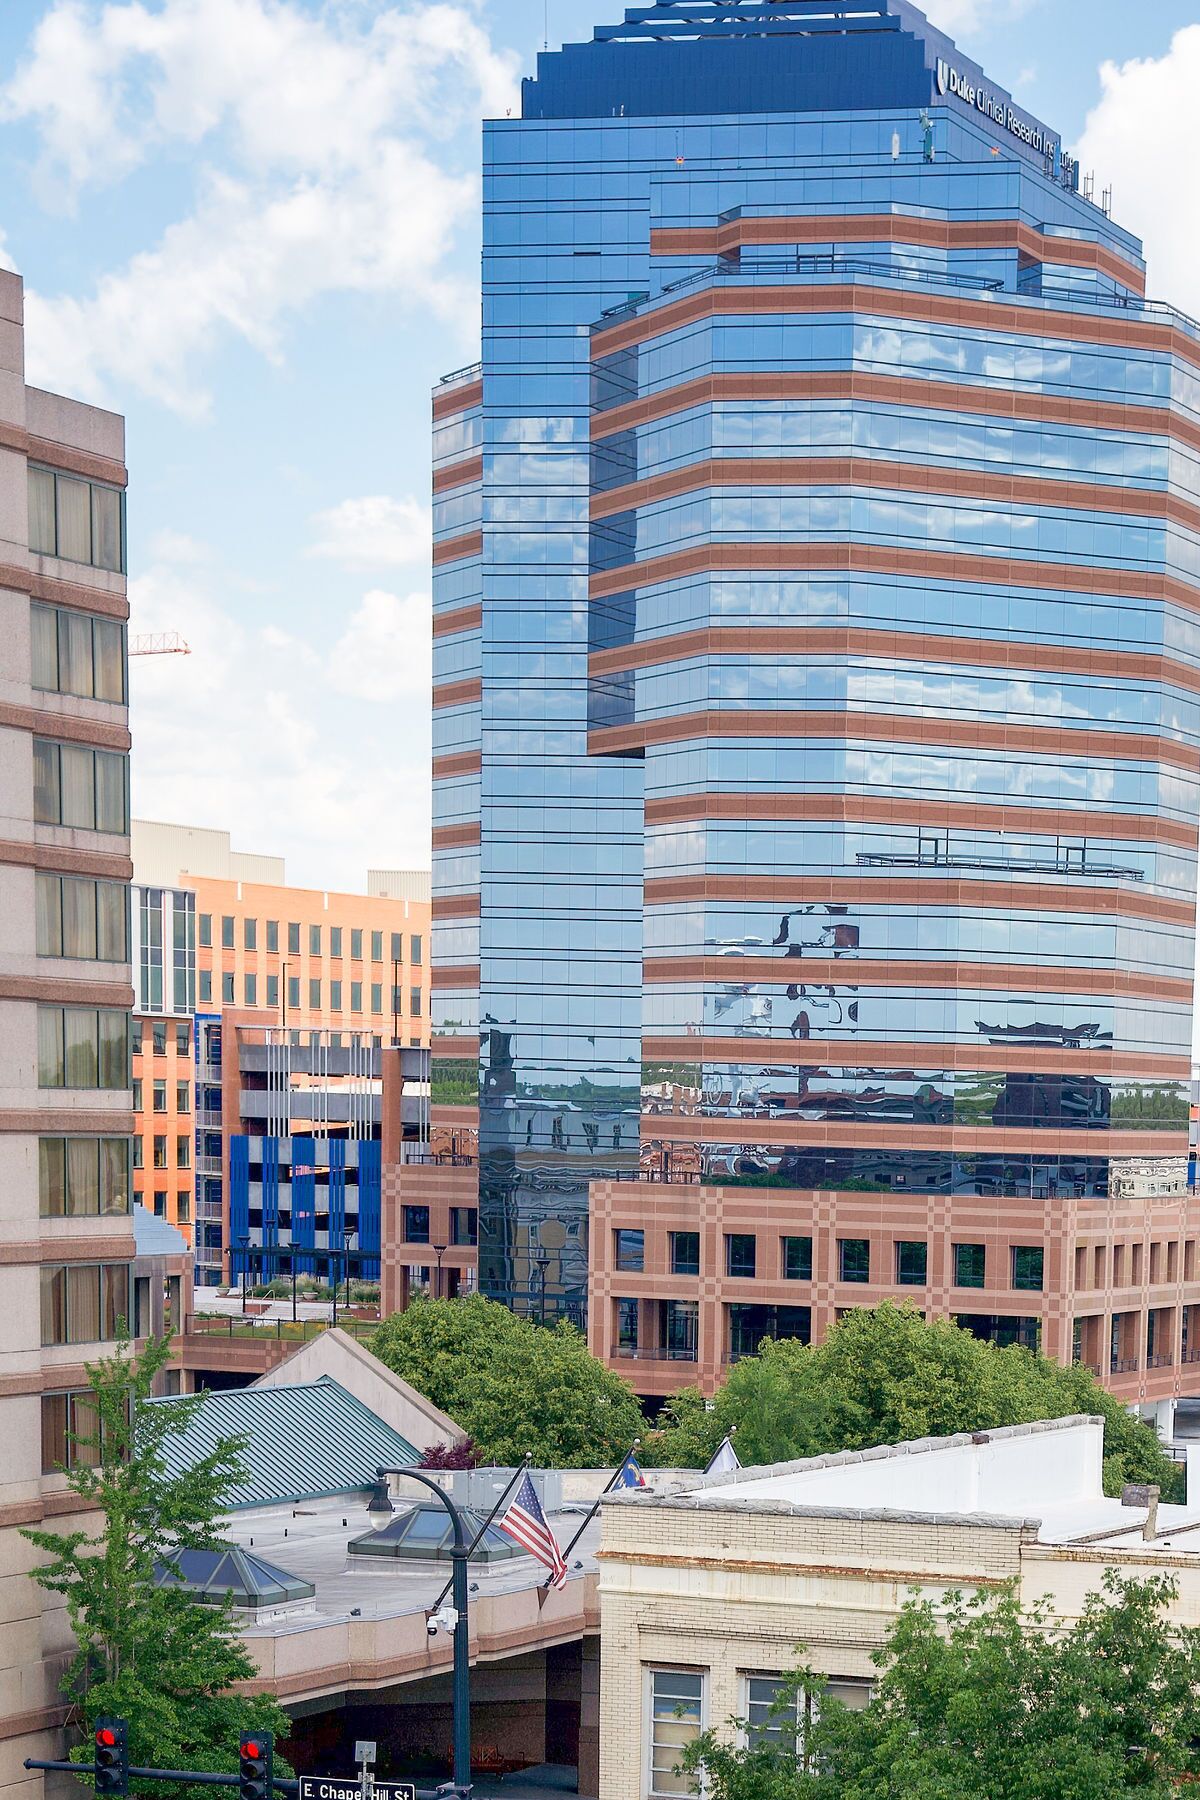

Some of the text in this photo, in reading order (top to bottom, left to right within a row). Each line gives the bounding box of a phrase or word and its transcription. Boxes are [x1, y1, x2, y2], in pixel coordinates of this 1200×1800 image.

[949, 68, 976, 105] Duke
[976, 88, 1006, 126] Clinical
[1007, 108, 1042, 152] Research
[304, 1783, 315, 1798] E.
